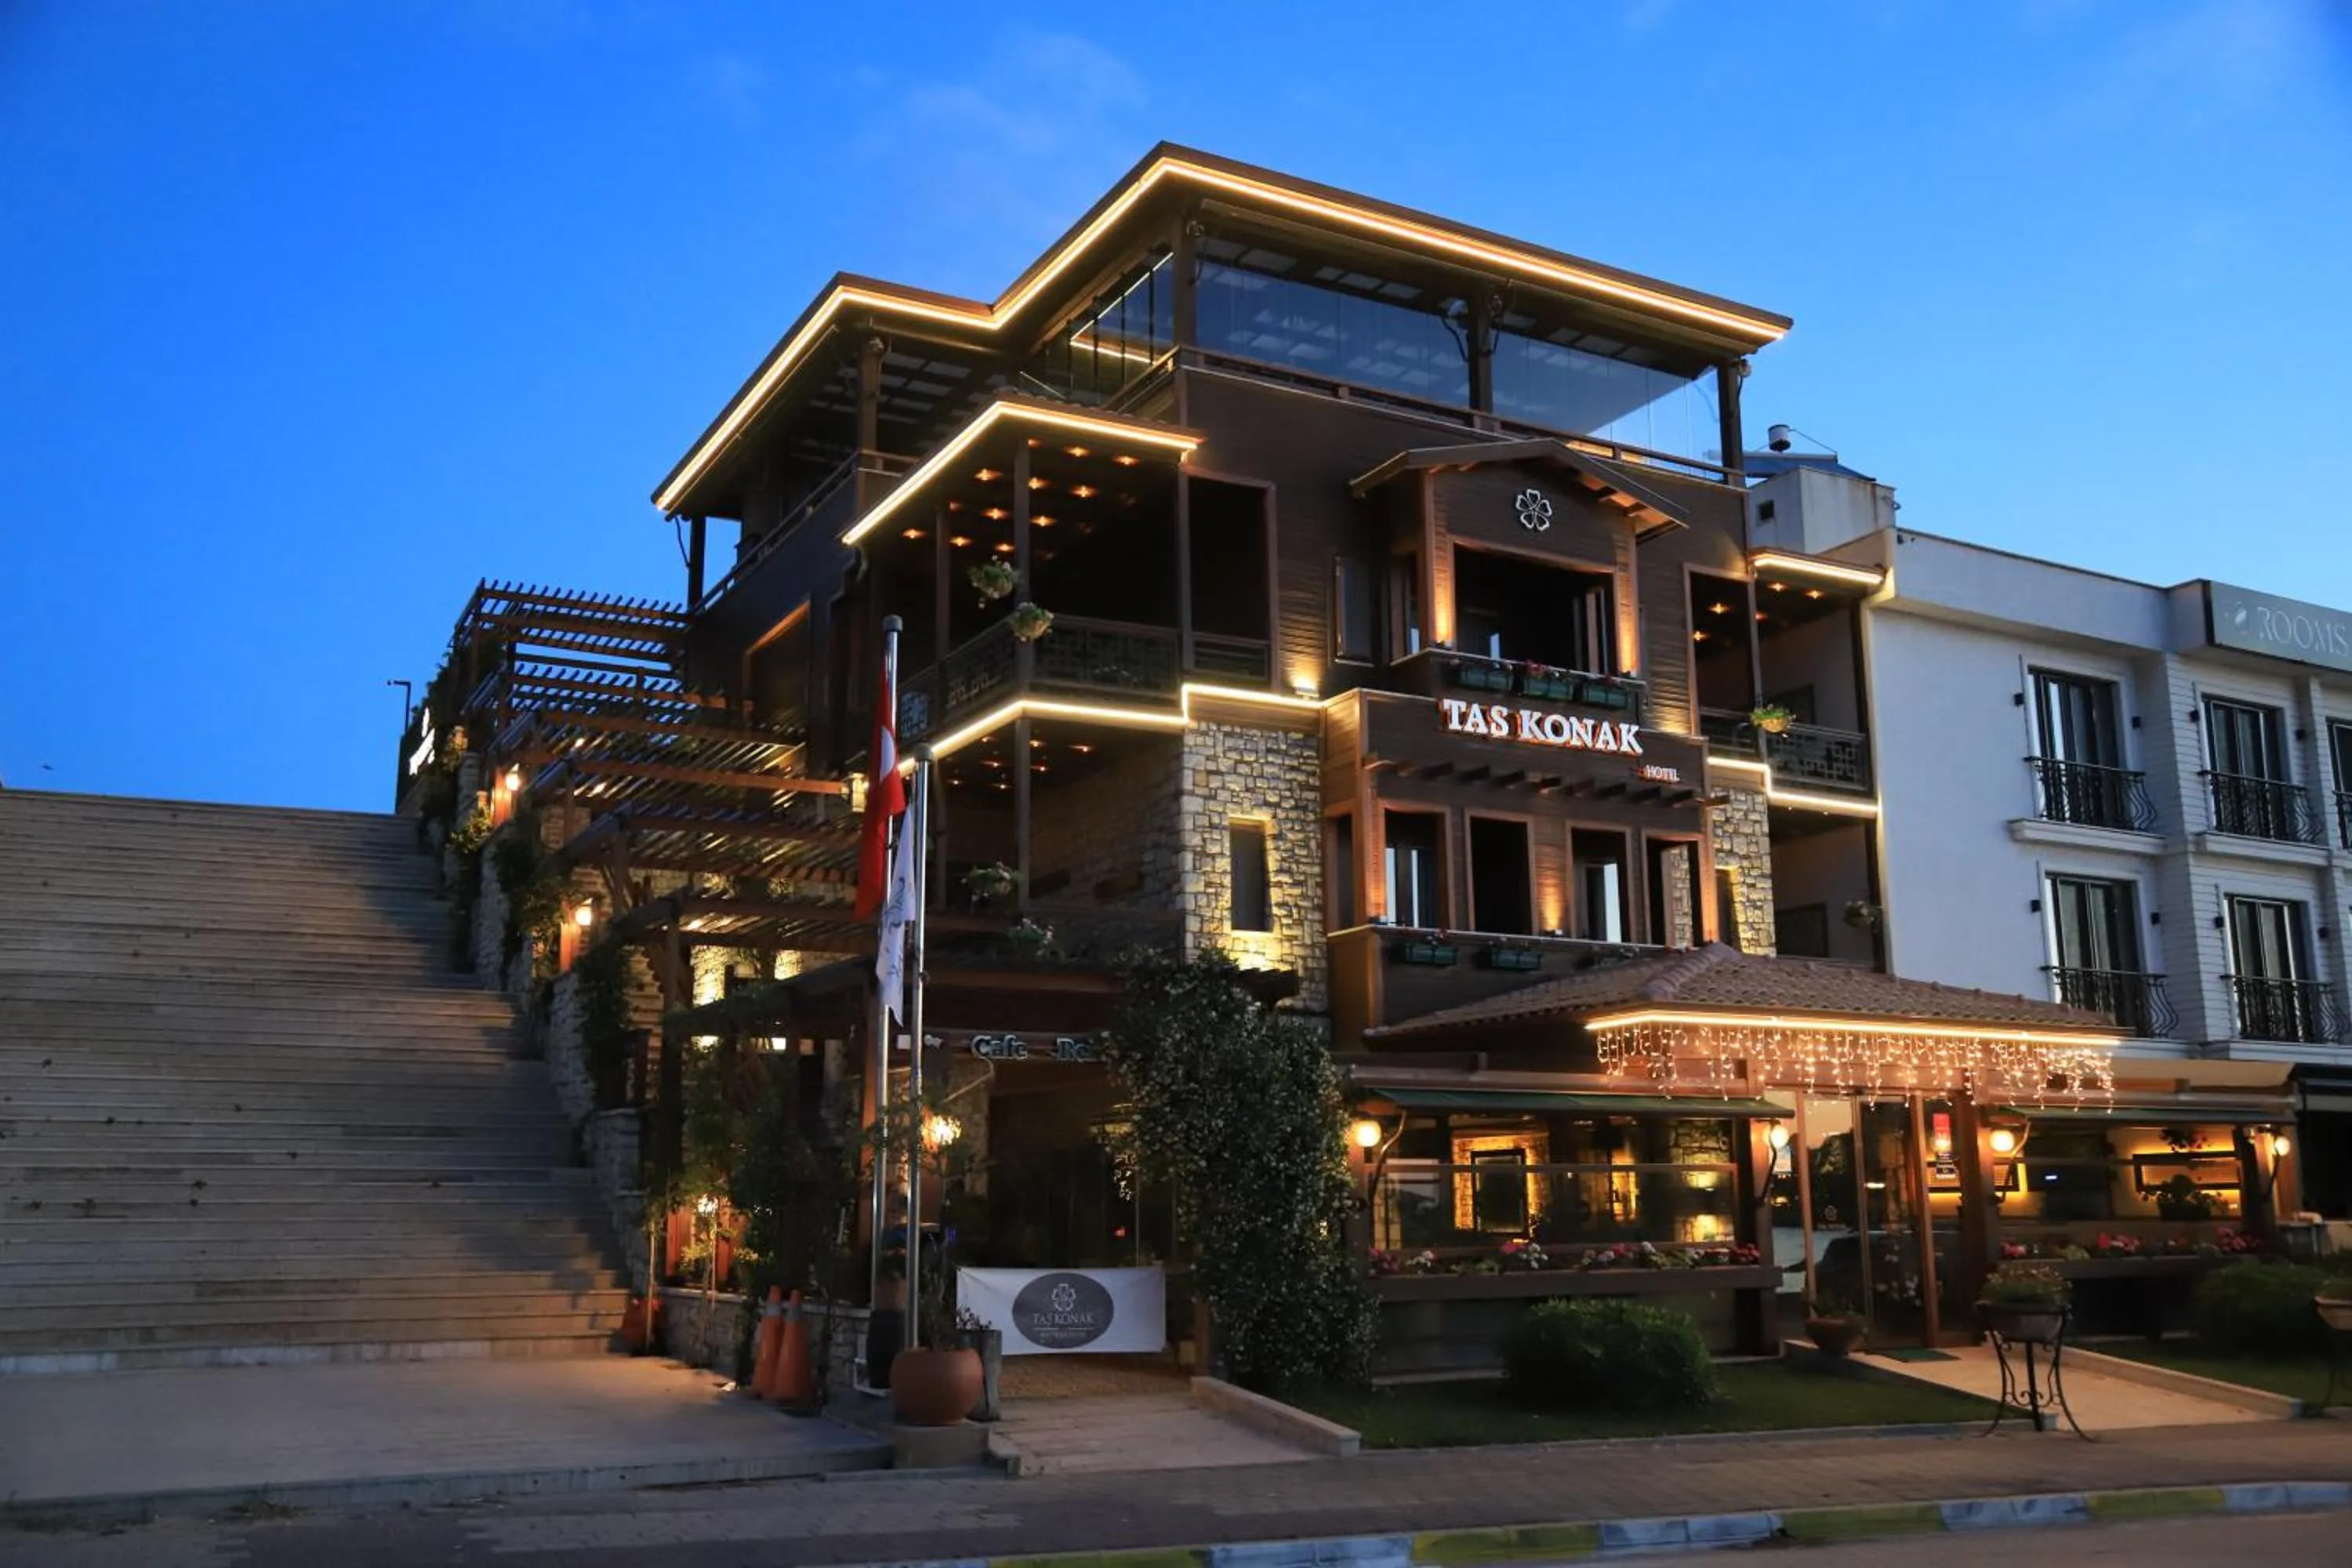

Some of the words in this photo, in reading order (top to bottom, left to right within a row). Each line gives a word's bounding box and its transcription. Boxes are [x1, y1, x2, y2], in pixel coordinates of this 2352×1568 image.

[2257, 606, 2348, 656] ROOMS
[1519, 710, 1643, 755] KONAK
[1644, 764, 1680, 782] HOTEL
